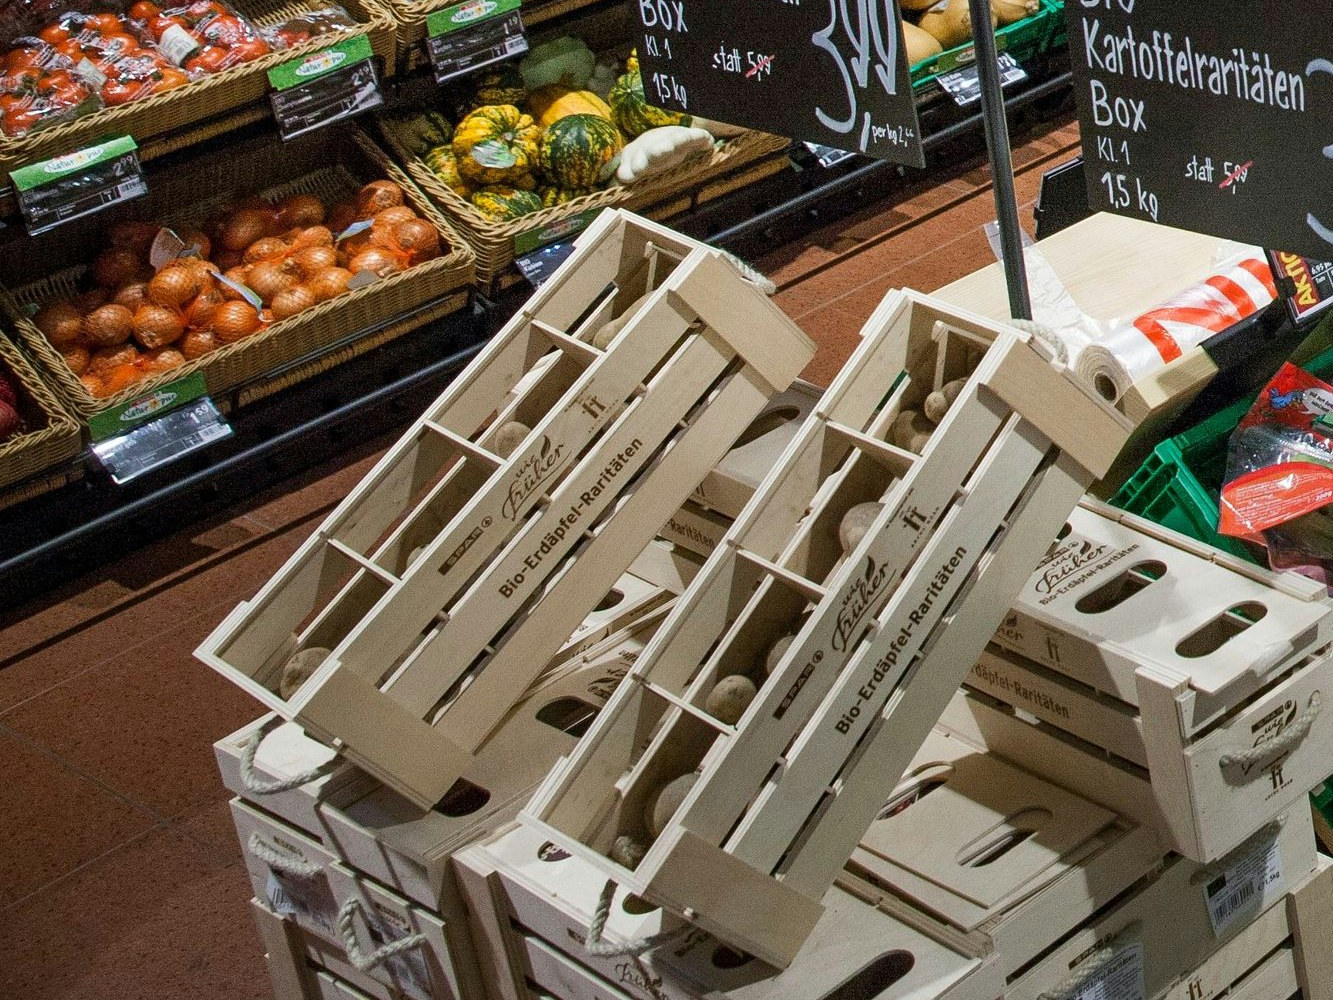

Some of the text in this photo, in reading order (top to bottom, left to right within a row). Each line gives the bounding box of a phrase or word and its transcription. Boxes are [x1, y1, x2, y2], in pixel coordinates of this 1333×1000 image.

[712, 40, 742, 74] statt
[1082, 17, 1305, 112] Kartoffelraritäten
[673, 76, 689, 109] kg
[1090, 79, 1147, 133] Box
[871, 125, 886, 144] per
[886, 123, 898, 145] kg
[1185, 154, 1214, 182] statt
[1101, 173, 1159, 222] 1,5 kg
[1280, 251, 1317, 306] AKTI
[502, 440, 565, 522] früher
[515, 454, 538, 478] wie
[498, 437, 644, 599] Bio-Erdäpfel-Raritäten
[445, 528, 483, 567] SPAR
[1035, 544, 1108, 594] früher
[1039, 543, 1140, 606] Bio-Erdäpfel-Raritäten
[831, 561, 889, 653] früher
[835, 546, 968, 736] Bio-Erdäpfel-Raritäten
